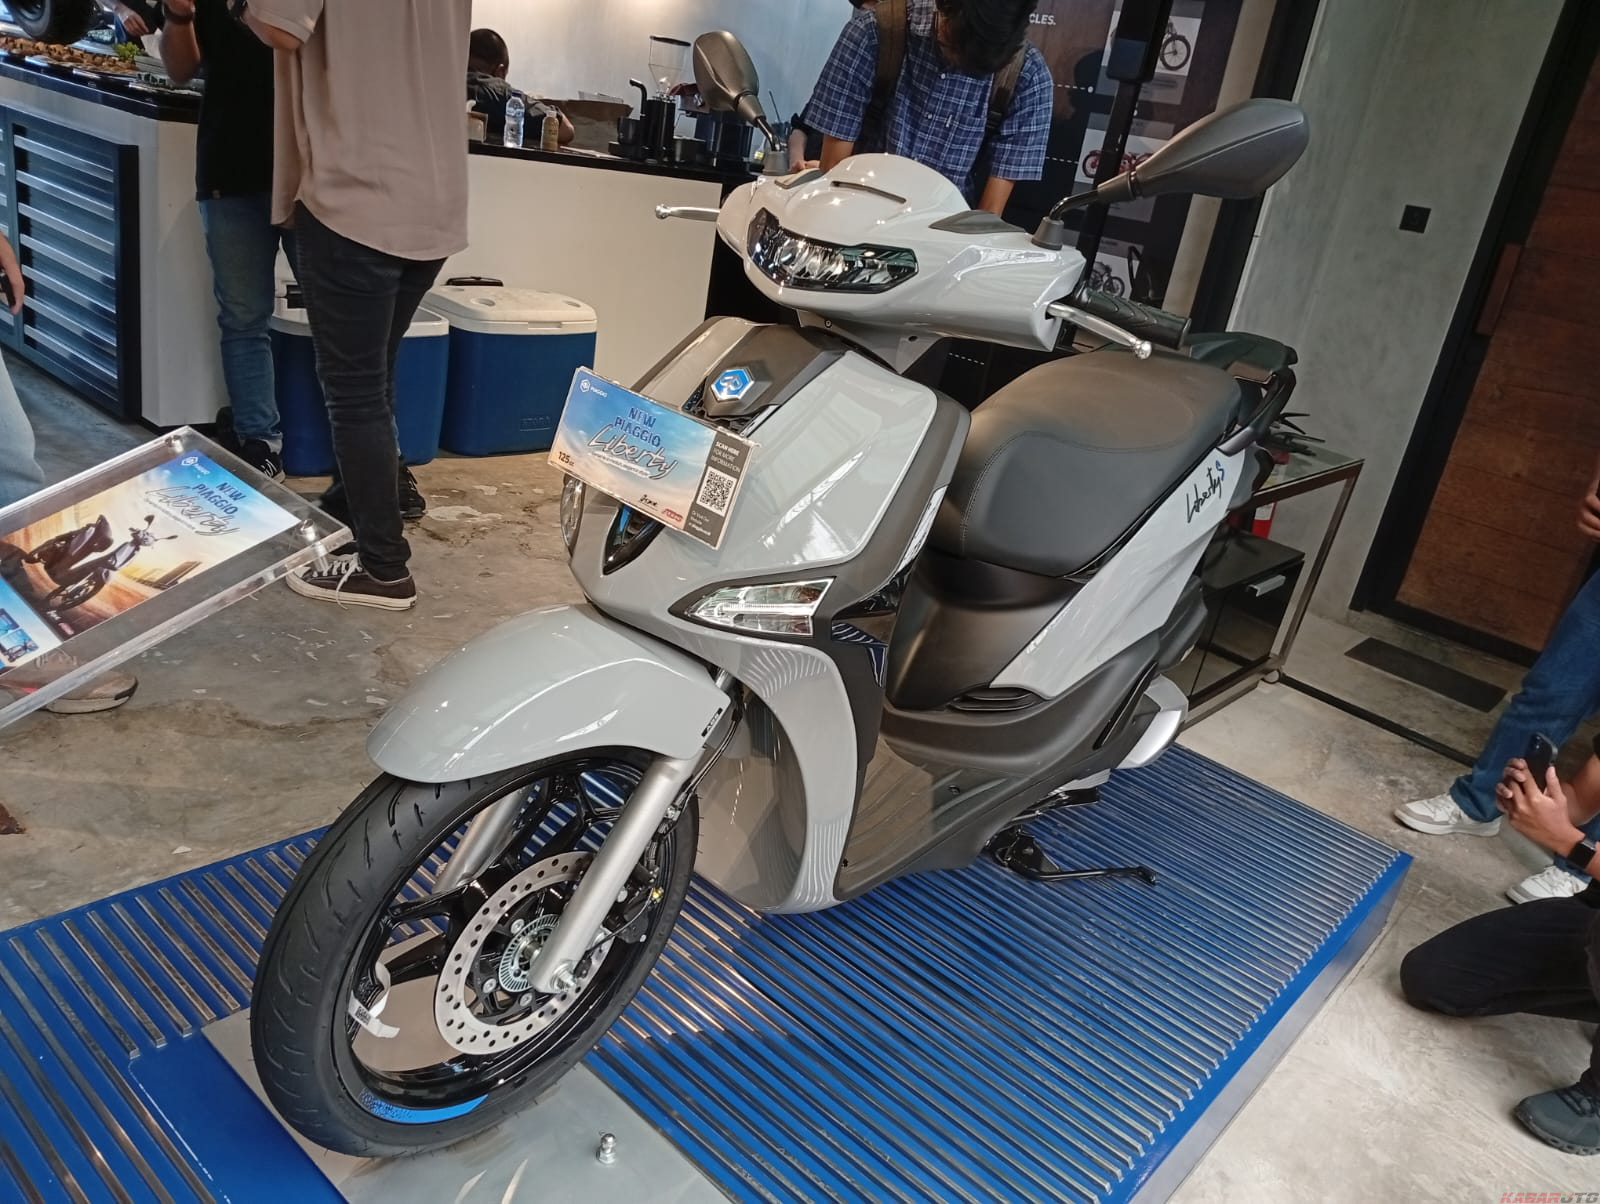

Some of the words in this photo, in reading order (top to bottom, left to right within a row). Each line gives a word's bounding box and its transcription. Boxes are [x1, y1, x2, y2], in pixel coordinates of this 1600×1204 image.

[628, 407, 657, 428] NEW
[614, 416, 661, 447] PIAGGIO
[558, 451, 570, 464] 125
[587, 424, 679, 480] Liberty
[715, 441, 728, 451] SCAN
[192, 483, 239, 515] PIAGGIO
[216, 482, 247, 502] NEW
[145, 485, 240, 537] Liberty
